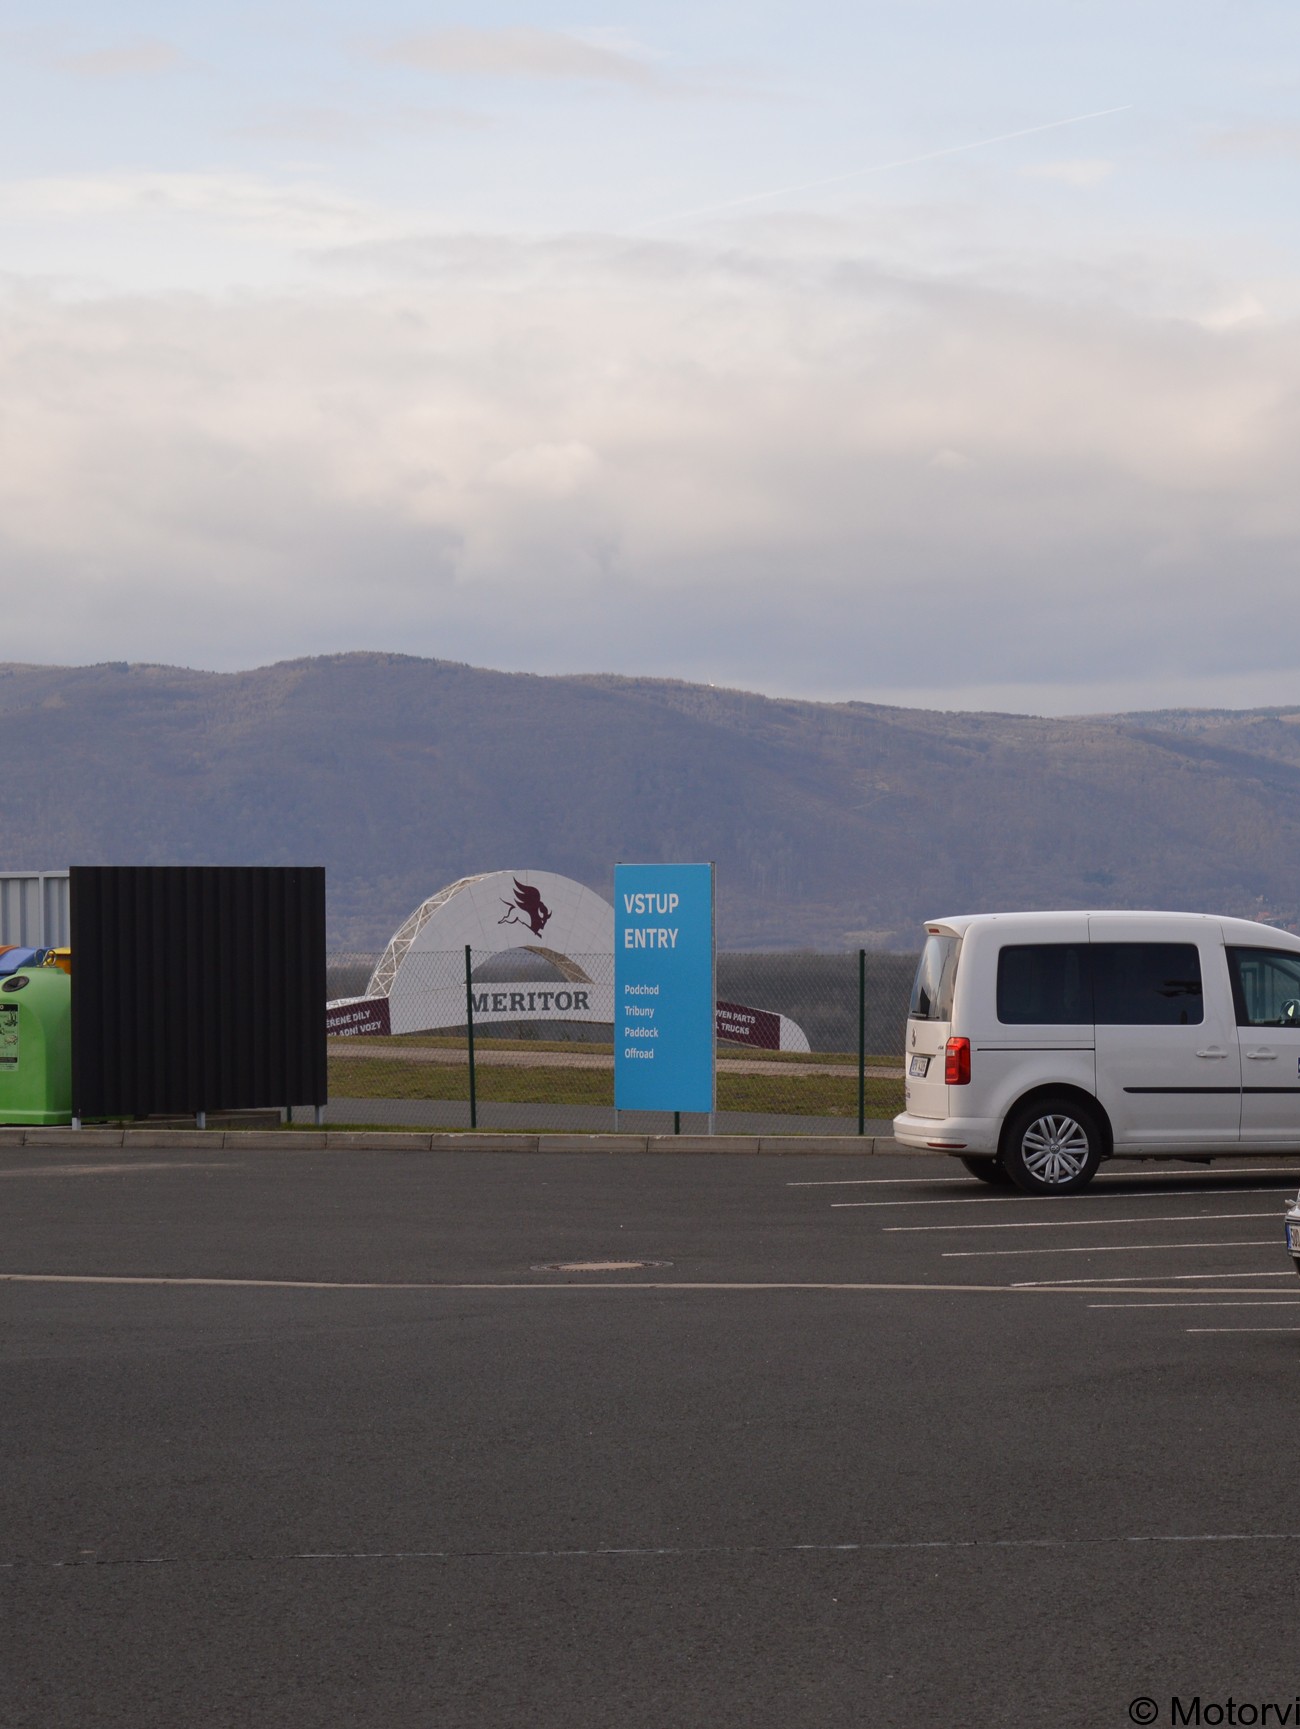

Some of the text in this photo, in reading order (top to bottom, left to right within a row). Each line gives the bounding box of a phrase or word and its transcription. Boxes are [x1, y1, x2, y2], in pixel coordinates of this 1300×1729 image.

[624, 894, 679, 914] VSTUP
[625, 928, 679, 949] ENTRY
[624, 984, 660, 995] Podchod
[466, 991, 590, 1012] MERITOR
[624, 1005, 655, 1019] Tribuny
[733, 1013, 756, 1024] PARTS
[360, 1021, 382, 1032] VOZY
[624, 1027, 659, 1038] Paddock
[721, 1022, 750, 1035] TRUCKS
[624, 1048, 654, 1059] Offroad
